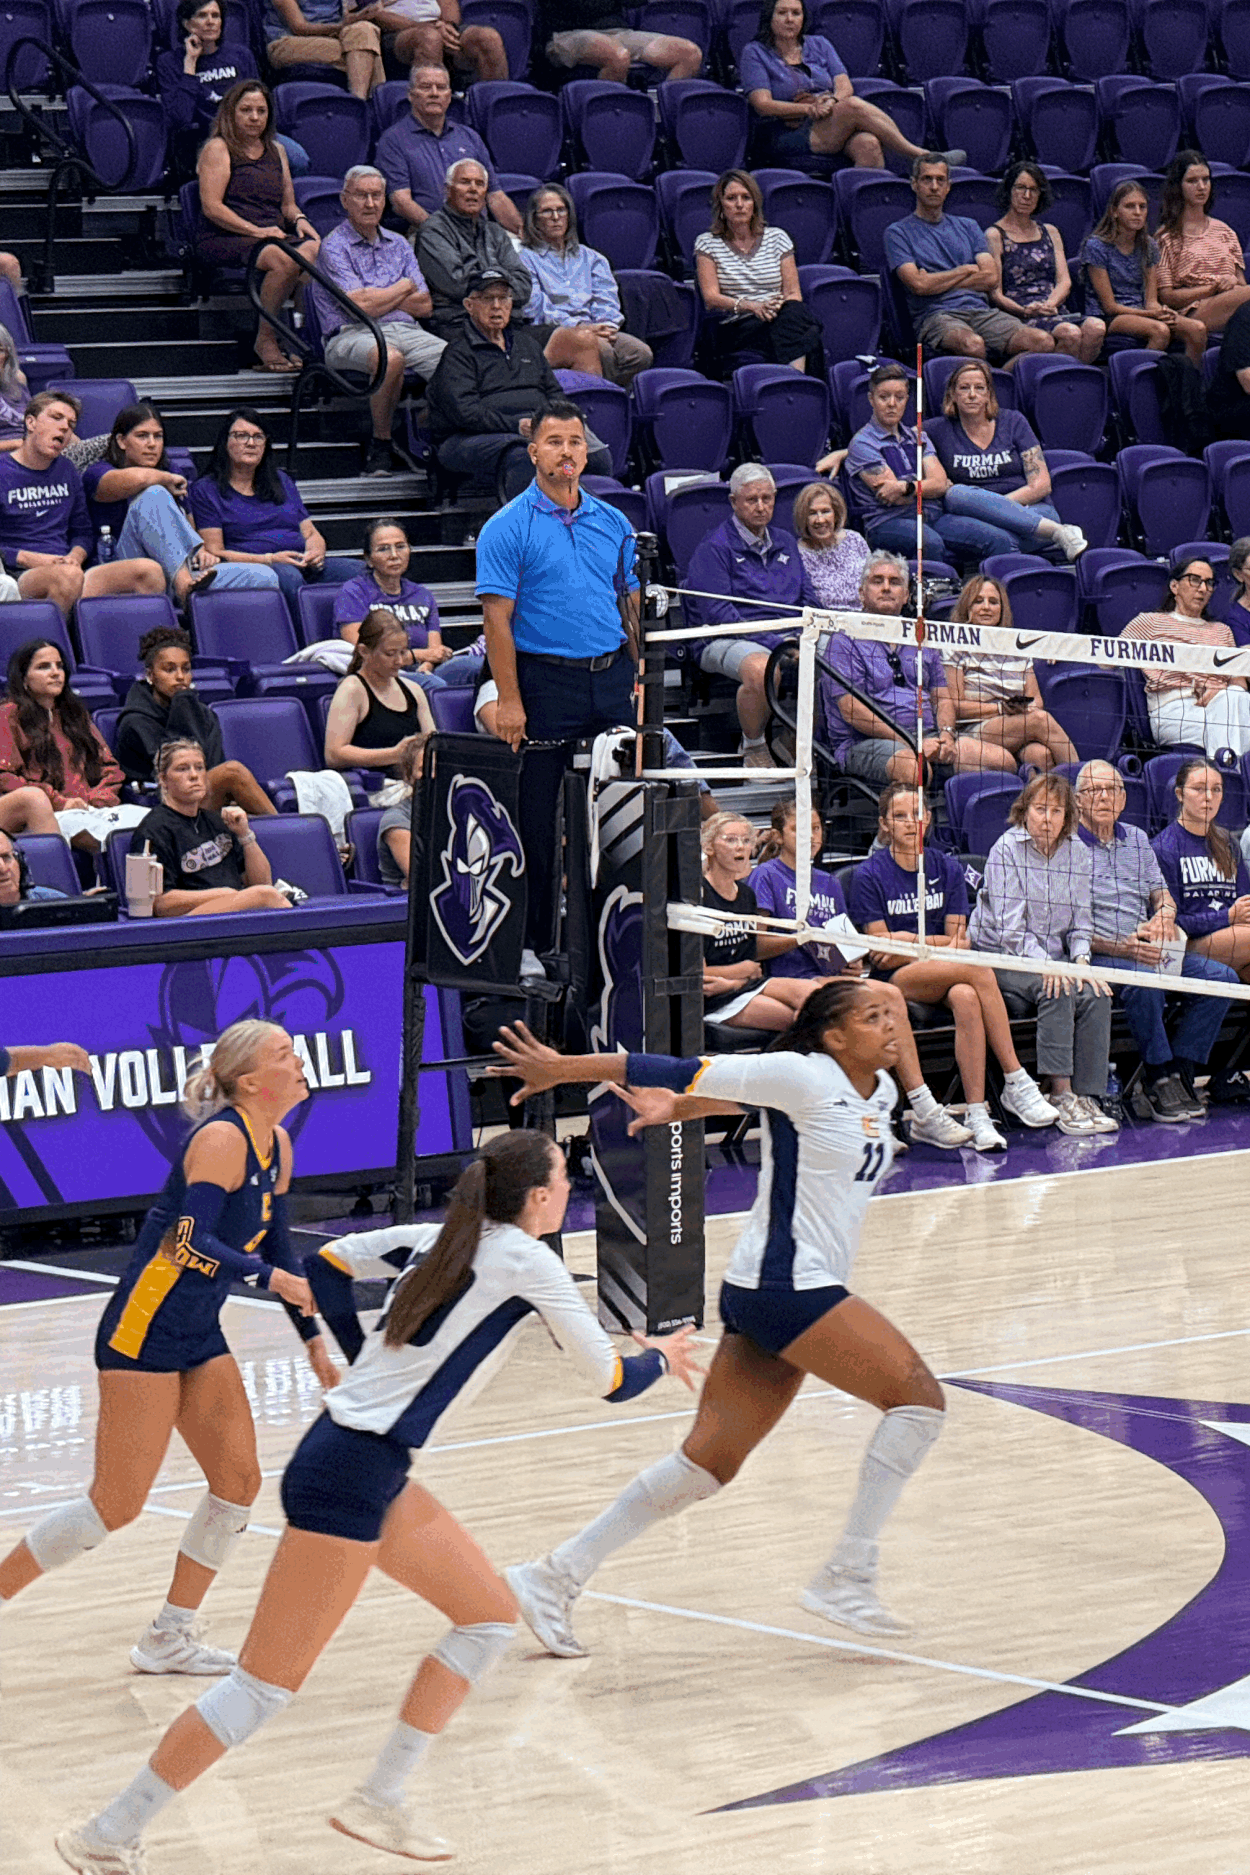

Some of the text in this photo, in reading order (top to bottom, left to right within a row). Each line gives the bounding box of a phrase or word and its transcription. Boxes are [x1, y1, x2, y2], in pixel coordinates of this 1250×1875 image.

[196, 66, 236, 83] RMAN
[953, 450, 1012, 468] FURMAN
[968, 465, 999, 478] MOM
[8, 483, 69, 504] FURMAN
[901, 620, 980, 645] FRMAN
[1090, 638, 1175, 663] FURMAN
[89, 1029, 371, 1110] VOLLALL
[854, 1142, 884, 1181] 11
[668, 1120, 682, 1244] ports imports
